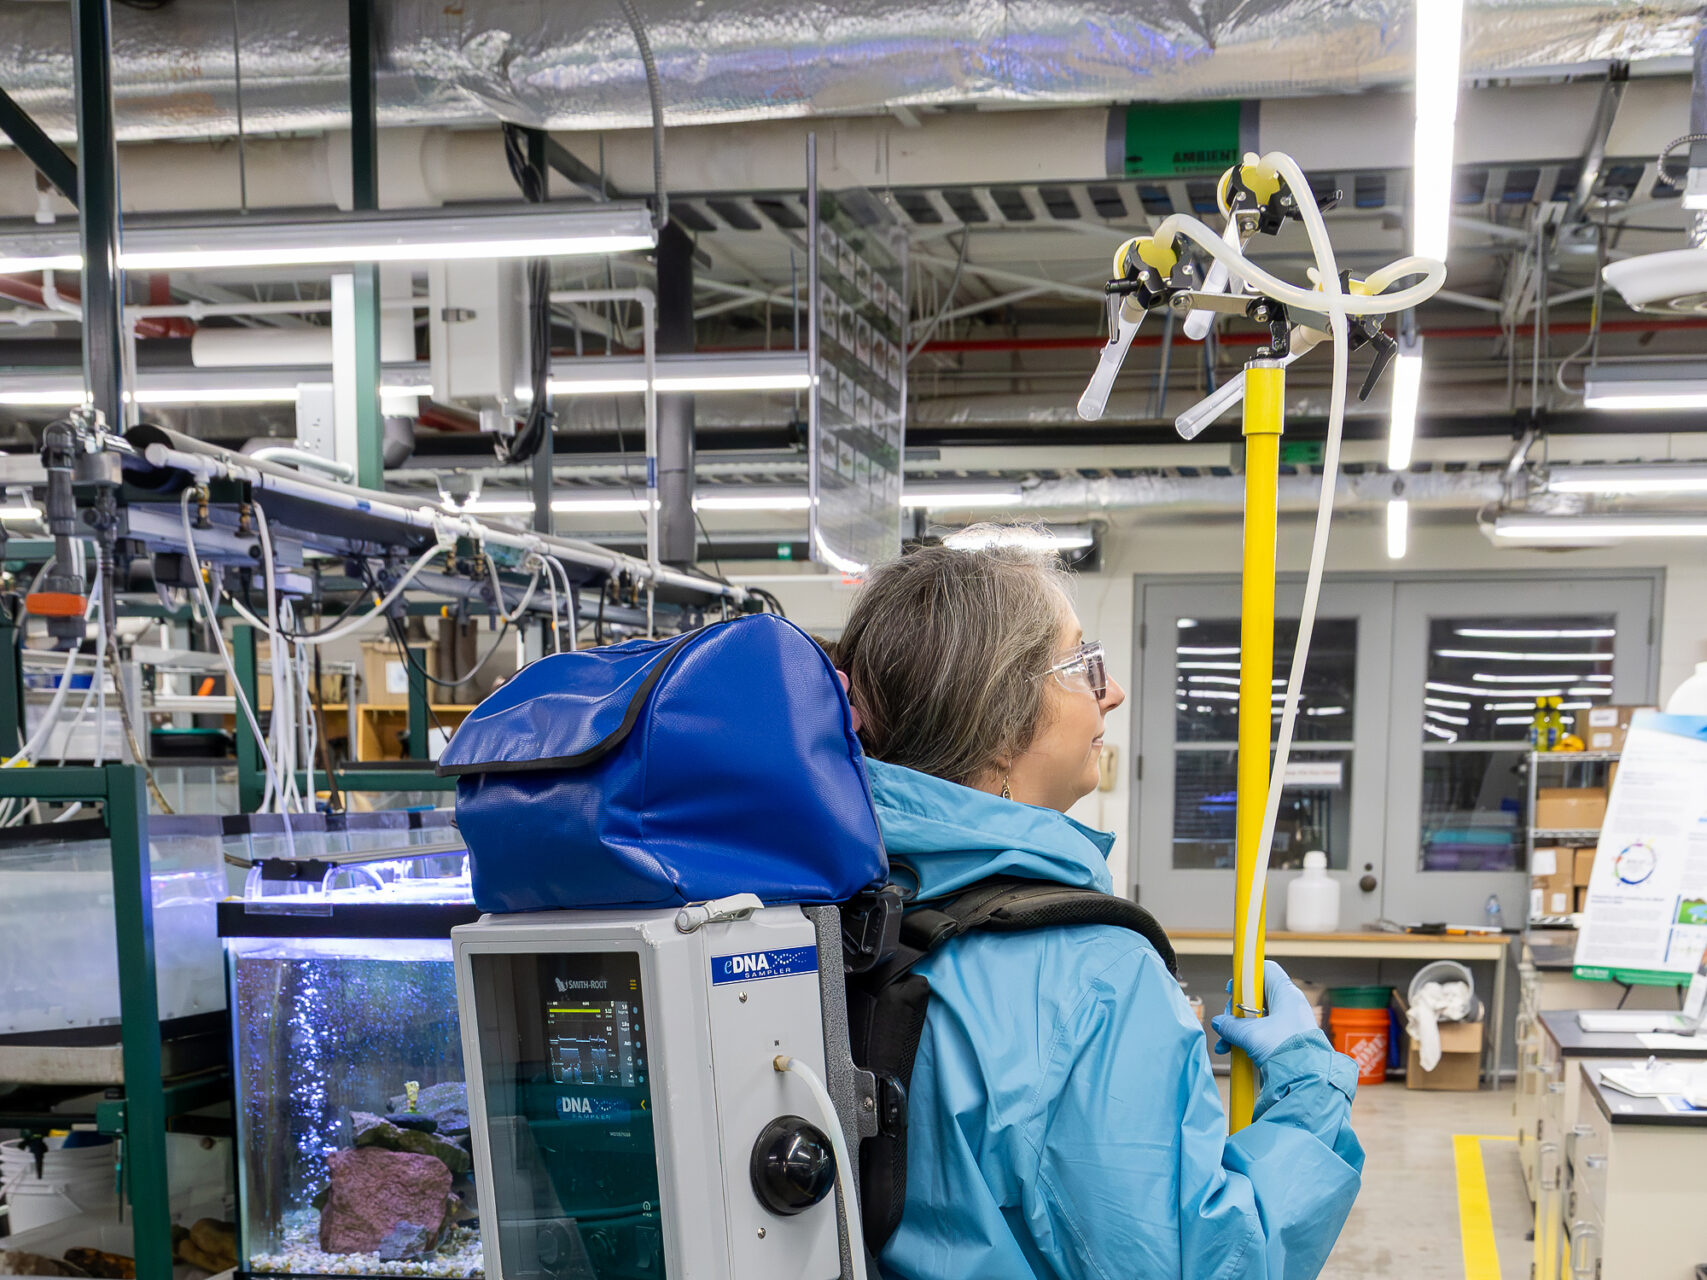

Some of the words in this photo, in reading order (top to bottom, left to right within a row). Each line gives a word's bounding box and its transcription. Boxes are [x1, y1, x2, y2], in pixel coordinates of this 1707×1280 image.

[1173, 149, 1237, 163] AMBIENT
[724, 953, 769, 975] eDNA
[744, 967, 791, 978] SAMPLER
[568, 979, 608, 989] SMITH-ROOT
